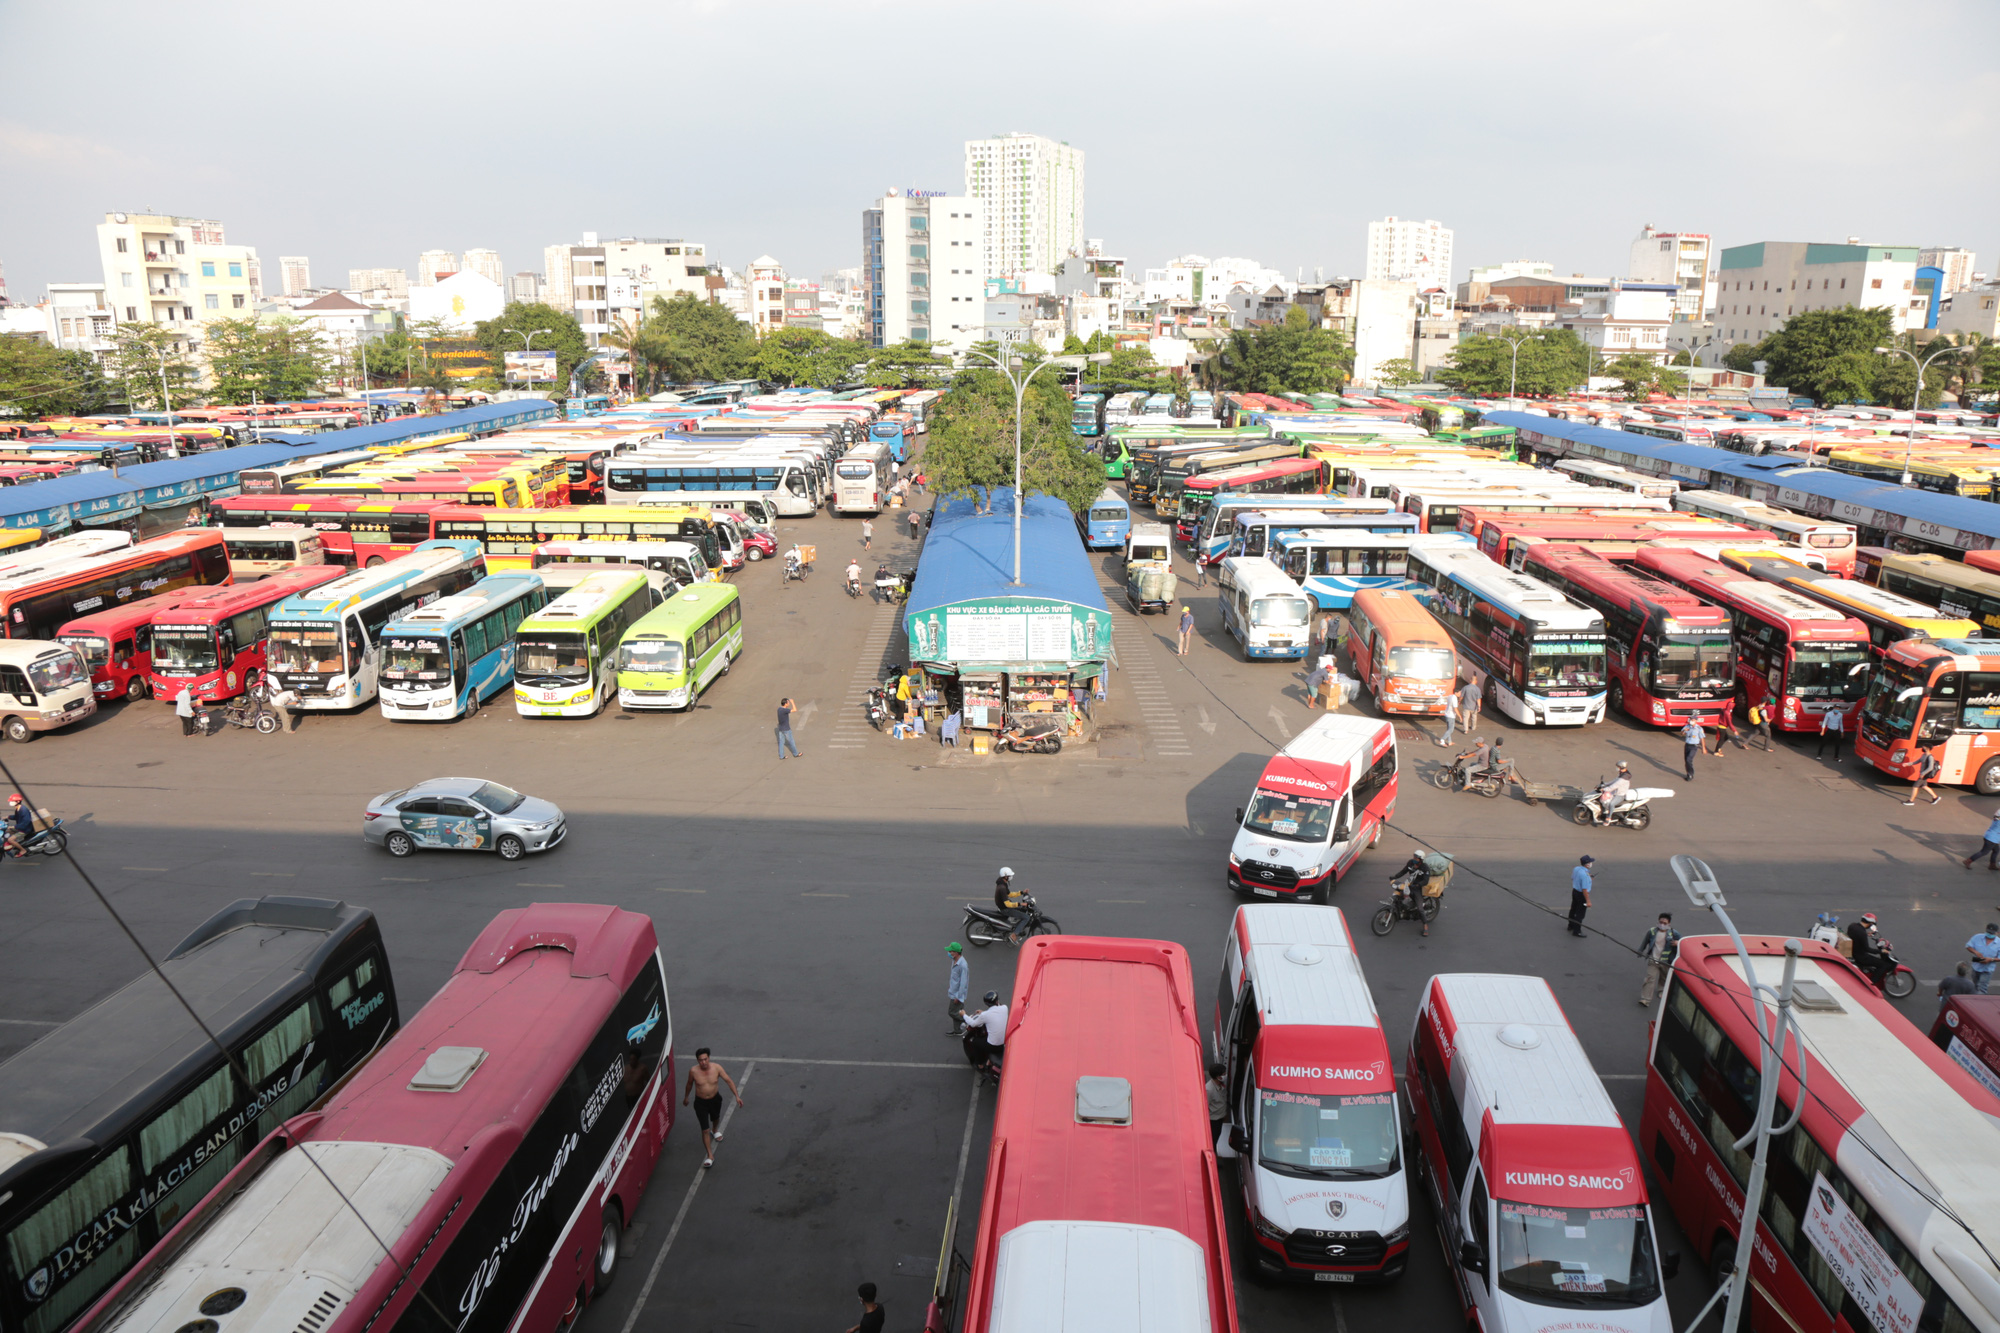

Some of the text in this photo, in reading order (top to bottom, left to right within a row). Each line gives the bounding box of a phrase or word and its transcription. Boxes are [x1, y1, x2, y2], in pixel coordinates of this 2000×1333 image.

[921, 190, 947, 198] Water
[1680, 466, 1691, 474] C.09
[214, 475, 228, 486] A.07
[156, 486, 175, 499] A.06
[1784, 490, 1800, 502] C.08
[91, 499, 110, 512] A.05
[1844, 504, 1862, 518] C.07
[17, 513, 39, 528] A.04
[1919, 523, 1941, 537] C.06
[962, 606, 977, 614] VỰC
[988, 606, 1003, 614] ĐẬU
[1004, 605, 1021, 613] CHỜ
[1022, 605, 1033, 613] TÀI
[1034, 604, 1049, 612] CÁC
[1051, 604, 1072, 612] TUYẾN
[1534, 641, 1603, 655] TRỌNG THẮNG
[1265, 775, 1327, 791] KUMHO SAMCO
[1255, 860, 1282, 869] DCAR
[341, 991, 385, 1030] New Home
[1959, 1023, 1983, 1052] TOÀN
[1270, 1066, 1374, 1081] KUMHO SAMCO
[1981, 1076, 1989, 1085] XE
[1262, 1091, 1321, 1107] BX.MIỀN ĐÔNG
[1375, 1094, 1391, 1104] TÀU
[1311, 1154, 1349, 1166] VŨNG TÀU
[54, 1208, 132, 1272] DCAR
[194, 1130, 227, 1165] SẠN
[229, 1115, 246, 1137] DI
[246, 1076, 288, 1120] ĐỘNG
[1505, 1172, 1624, 1191] KUMHO SAMCO
[1284, 1191, 1320, 1206] LIMOUSINE
[1372, 1199, 1386, 1210] GIA
[1501, 1203, 1567, 1221] BX.MIỀN ĐÔNG
[1589, 1207, 1644, 1220] BX.VŨNG TÀU
[1705, 1162, 1778, 1274] KUMHO SAMC SLINES
[1315, 1230, 1359, 1239] DCAR
[1811, 1207, 1820, 1224] TP.
[1820, 1219, 1829, 1234] HỒ
[1828, 1229, 1841, 1247] CHÍ
[1839, 1243, 1855, 1269] MINH
[1857, 1233, 1873, 1253] SAMCO
[1560, 1280, 1604, 1292] MIỀN ĐÔNG
[1826, 1249, 1886, 1332] (028) 35 112 112
[1876, 1301, 1905, 1333] NHA TRAN
[1887, 1294, 1913, 1329] ĐÀ LẠT
